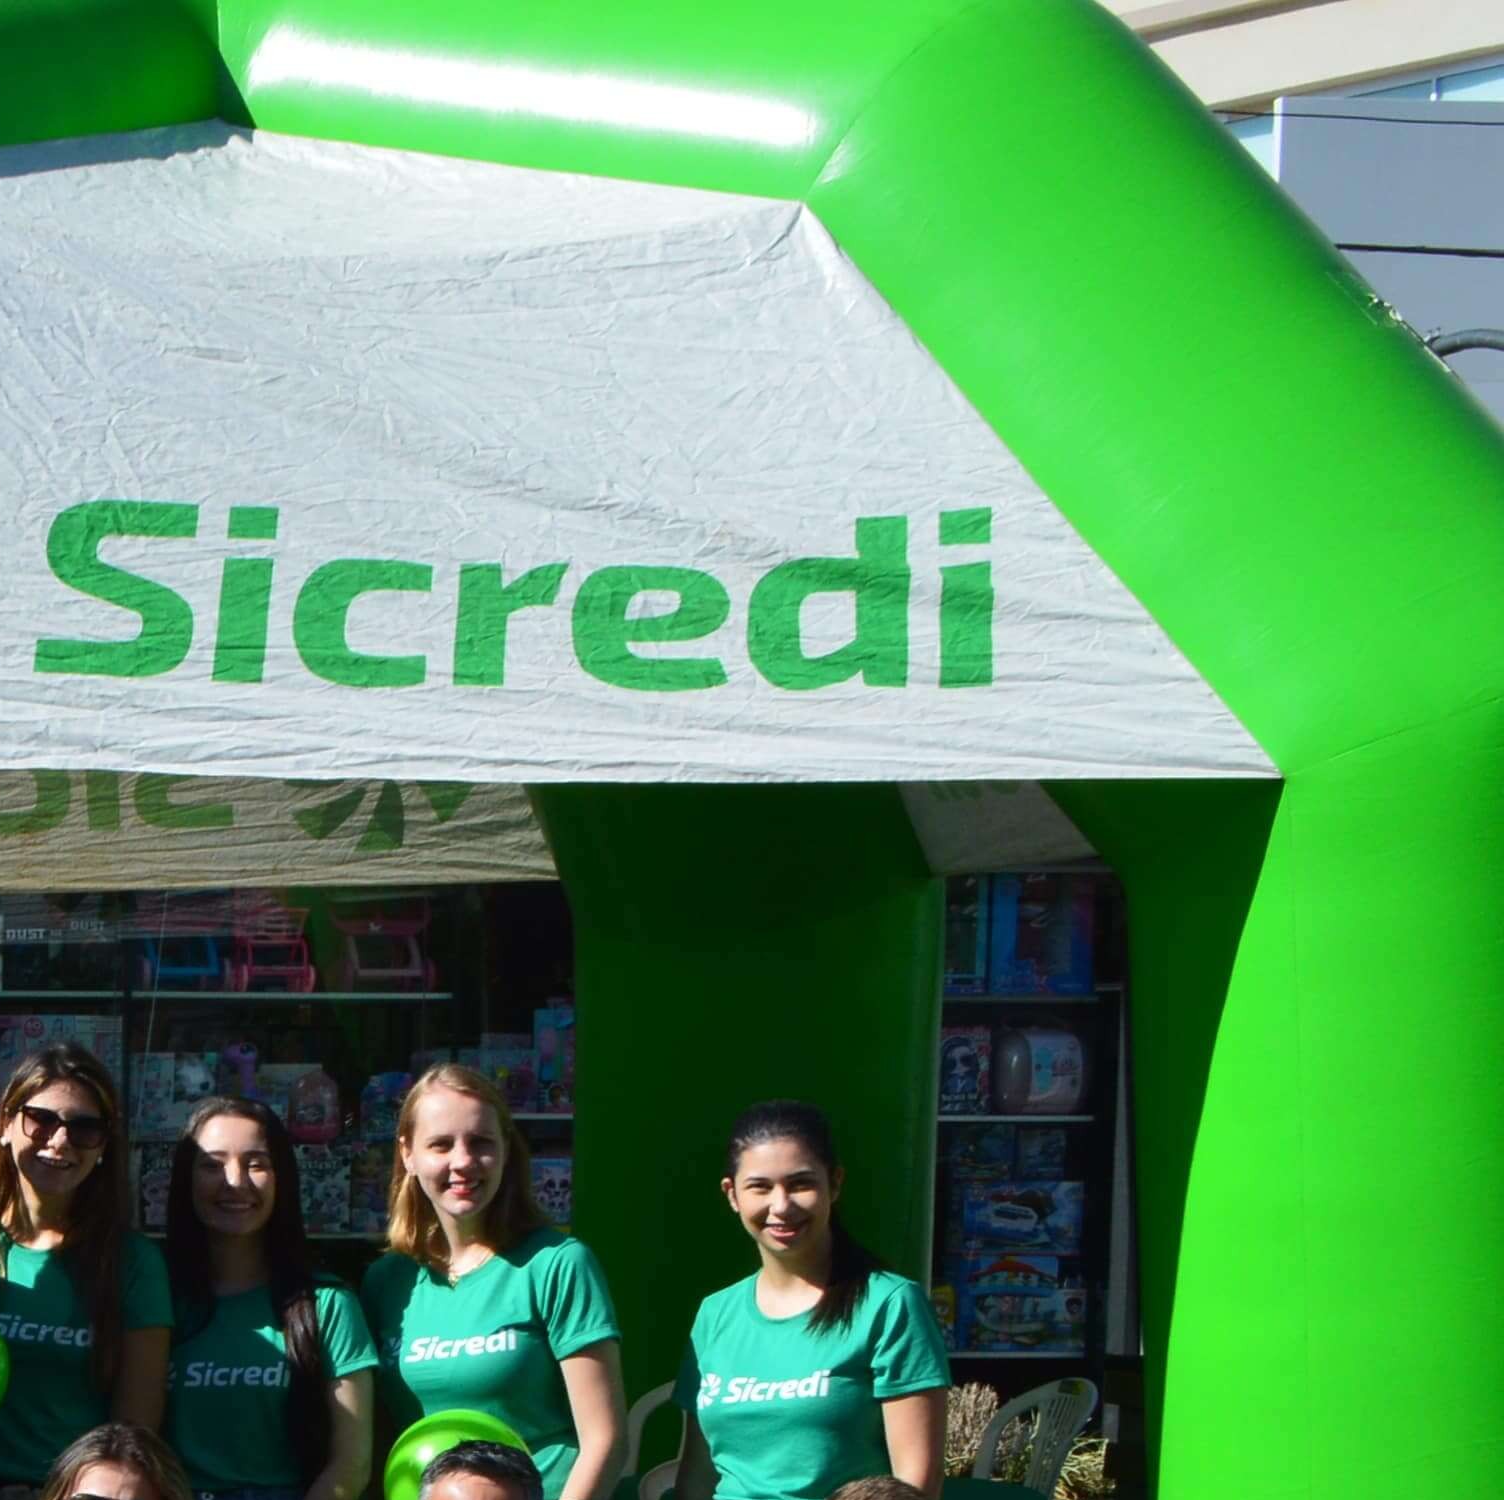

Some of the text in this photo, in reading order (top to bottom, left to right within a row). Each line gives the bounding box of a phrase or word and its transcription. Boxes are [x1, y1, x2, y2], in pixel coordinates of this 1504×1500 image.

[35, 501, 993, 690] Sicredi
[406, 1328, 517, 1363] Sicredi
[721, 1369, 831, 1404] Sicredi
